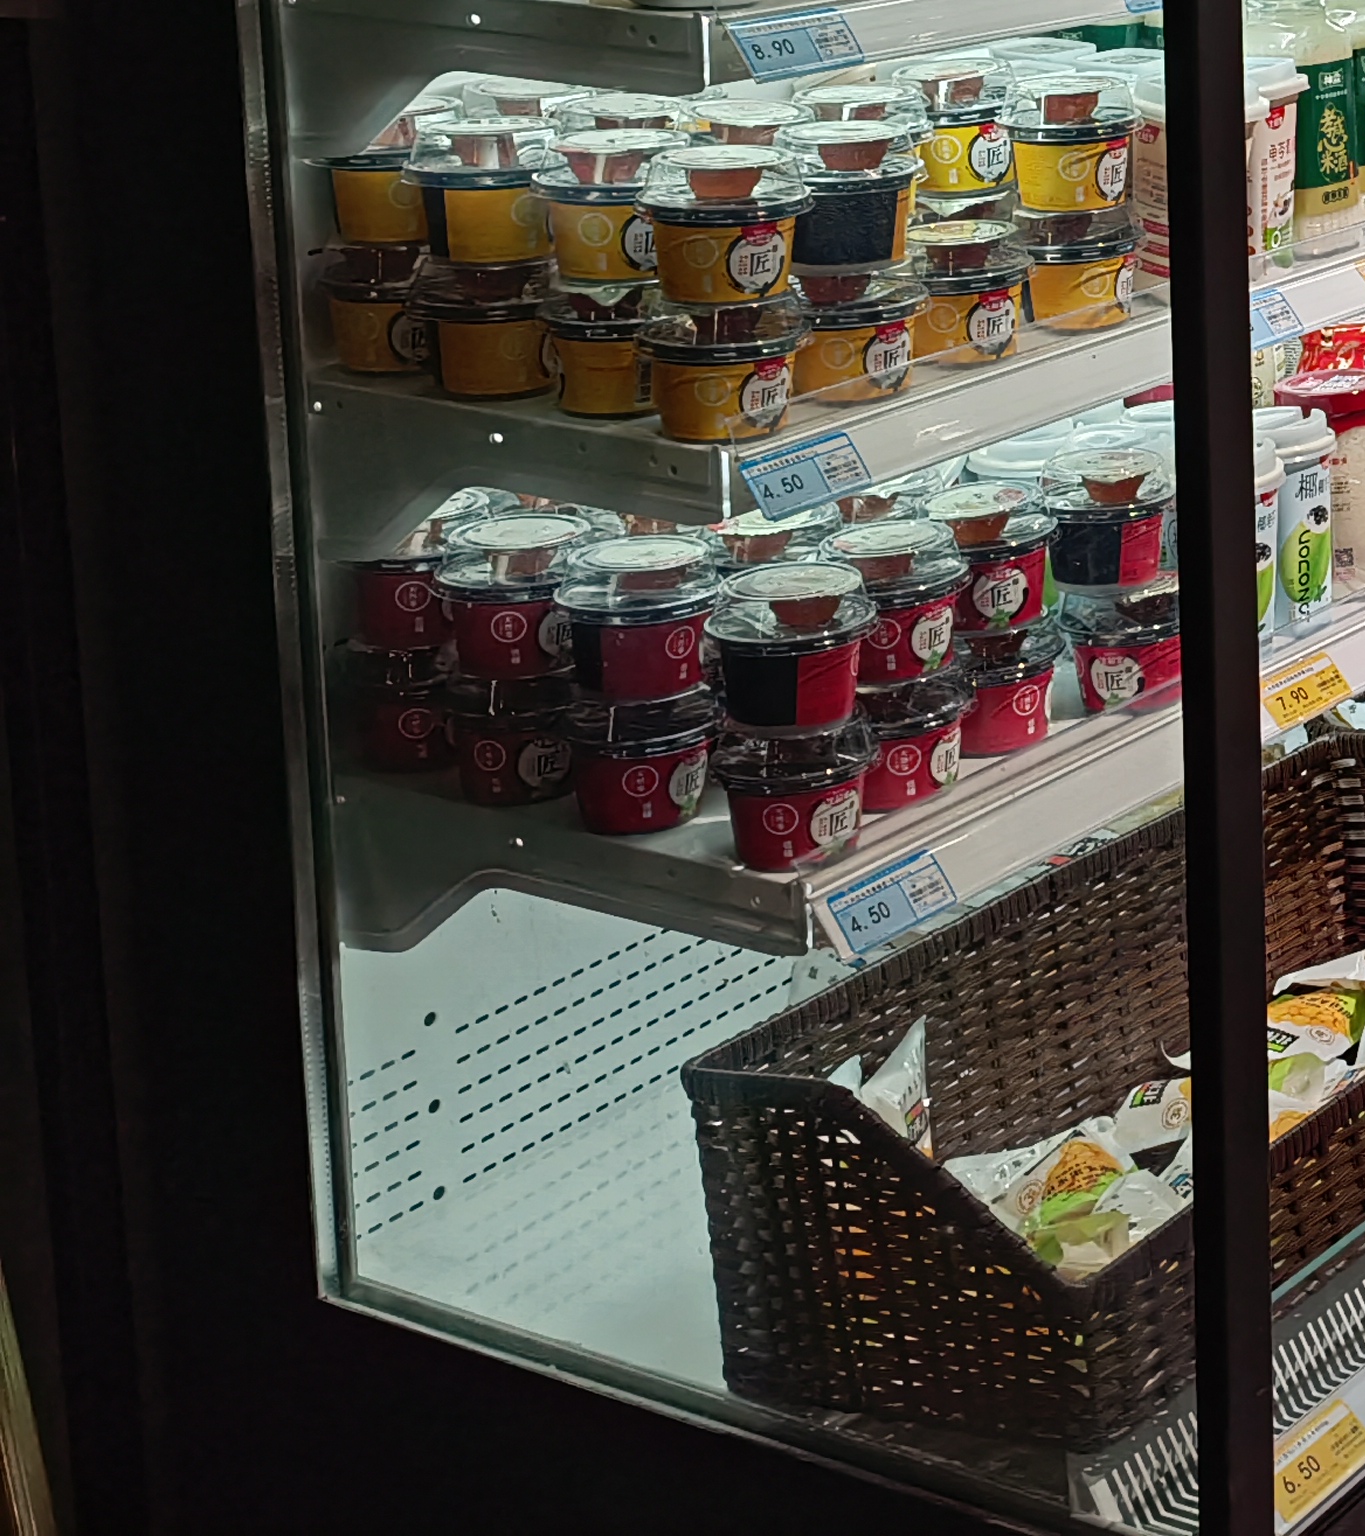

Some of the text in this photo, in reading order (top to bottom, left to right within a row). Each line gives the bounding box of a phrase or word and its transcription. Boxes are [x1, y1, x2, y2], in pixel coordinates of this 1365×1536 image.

[751, 38, 795, 60] 8.90
[762, 473, 805, 500] 4.50
[1276, 687, 1308, 710] 7.90
[850, 901, 892, 933] 4.50
[1282, 1454, 1321, 1495] 6.50
